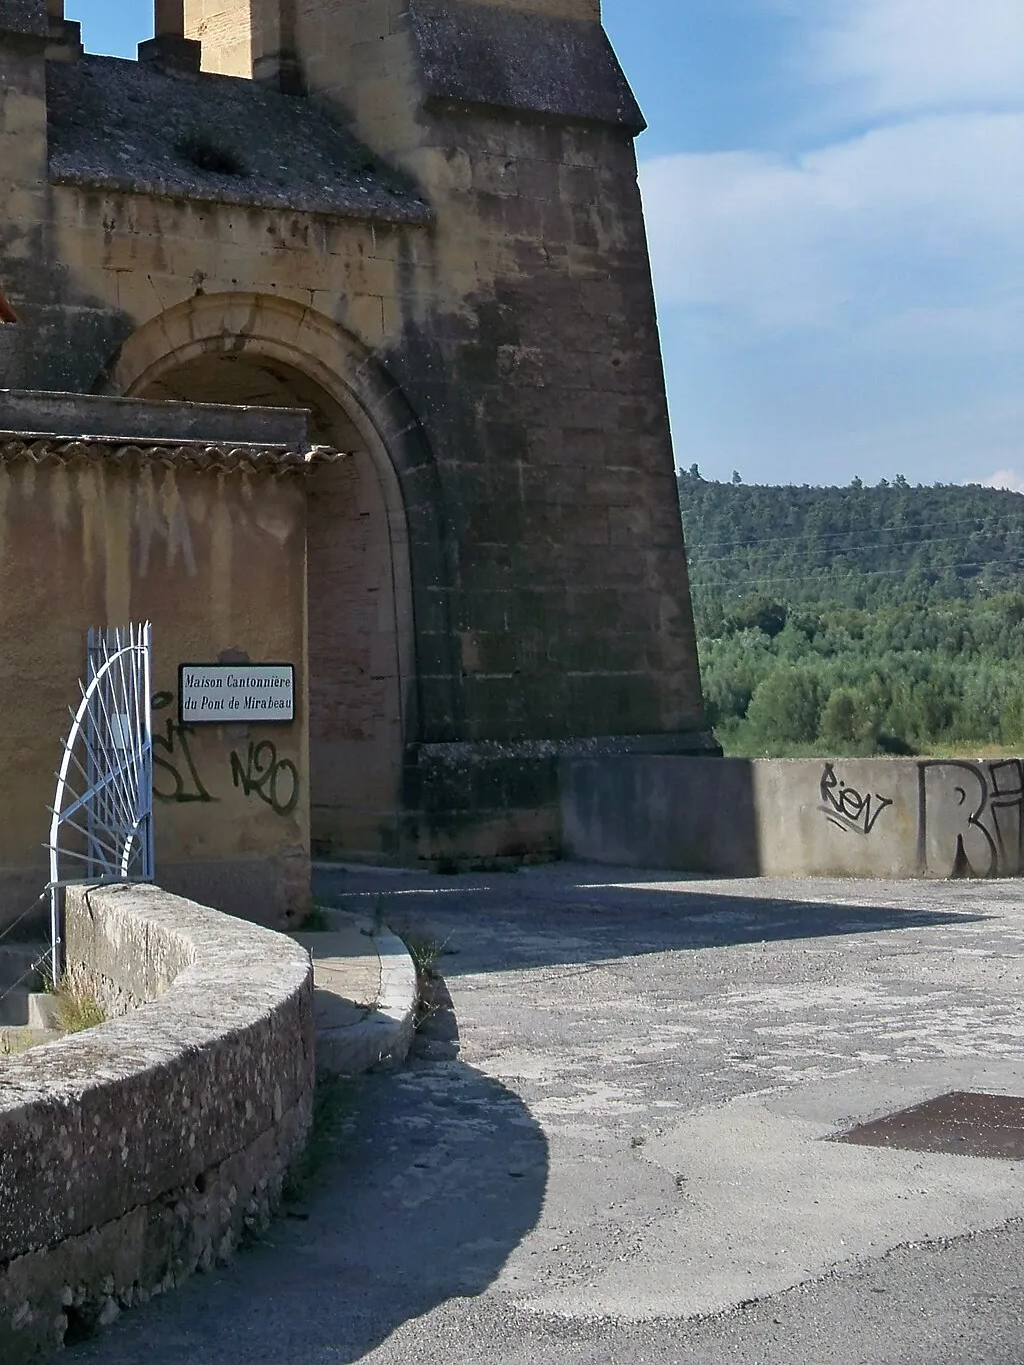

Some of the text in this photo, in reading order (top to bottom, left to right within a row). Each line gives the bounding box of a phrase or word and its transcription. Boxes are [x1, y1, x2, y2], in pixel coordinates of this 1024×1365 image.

[185, 674, 291, 687] Maison Cantonnière
[184, 696, 291, 709] du Pont de Mirabeau
